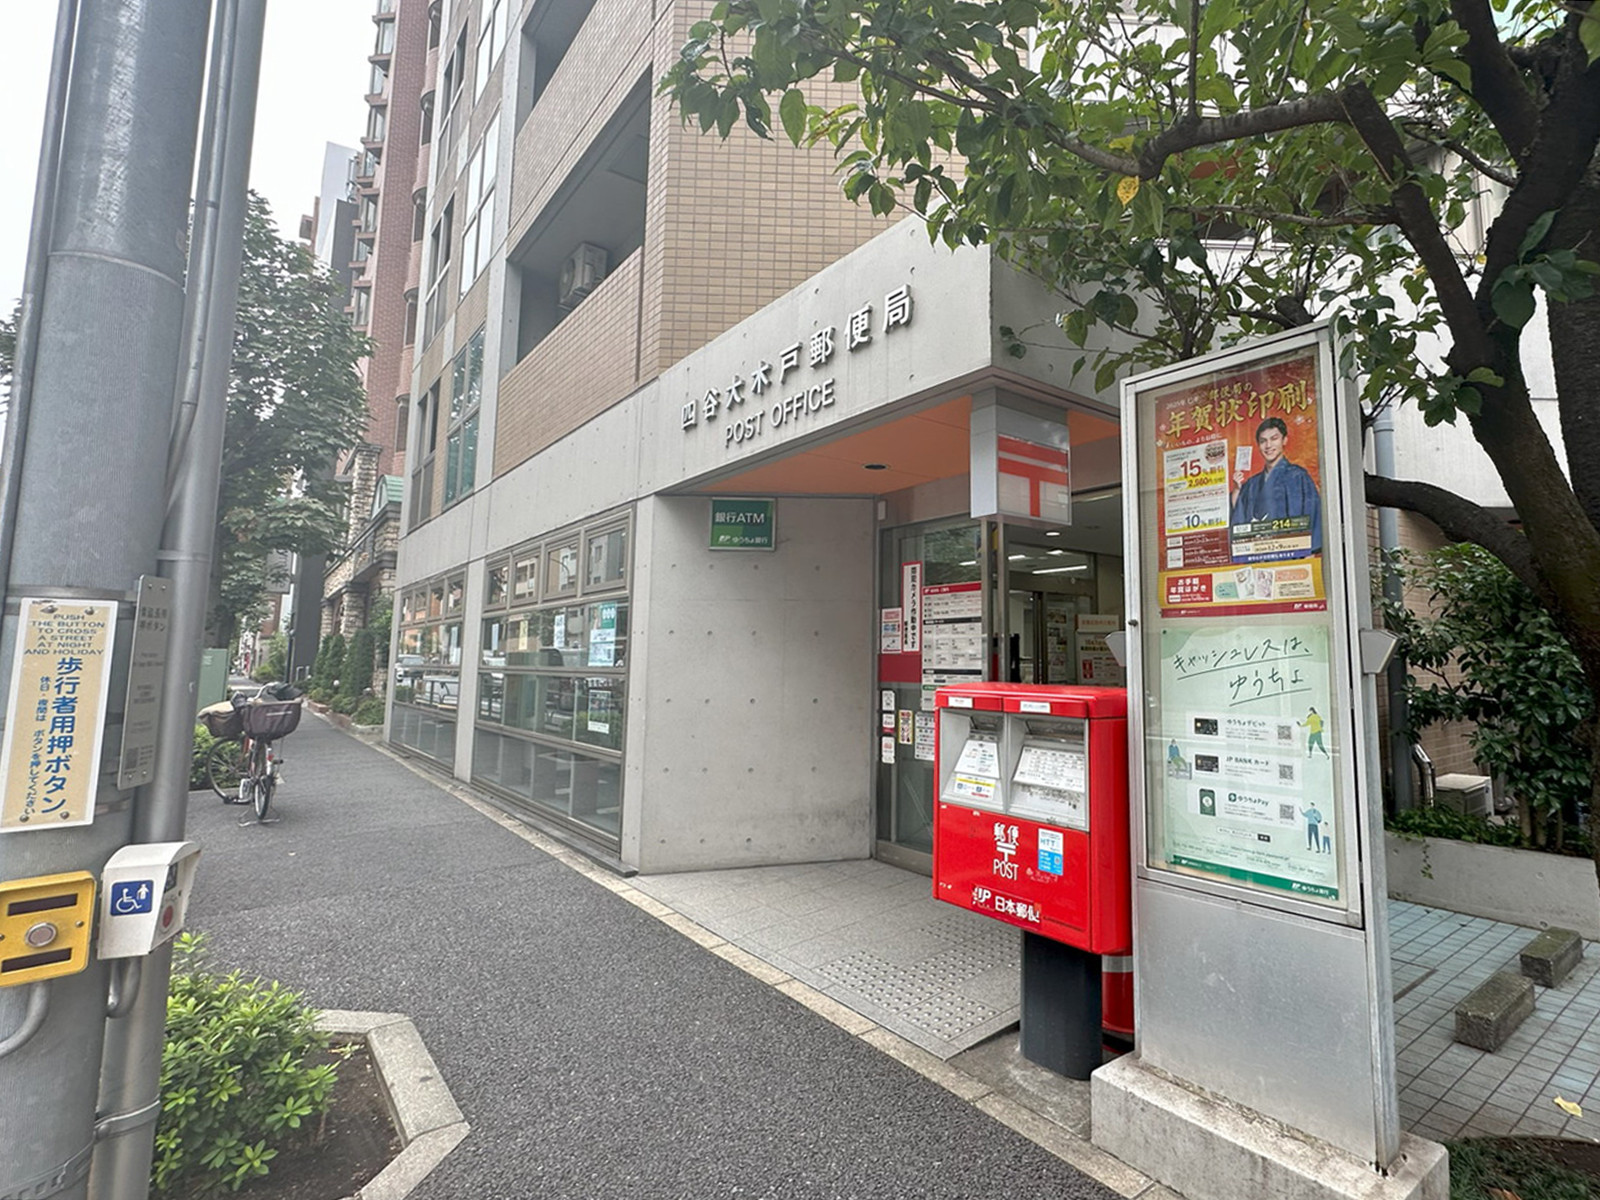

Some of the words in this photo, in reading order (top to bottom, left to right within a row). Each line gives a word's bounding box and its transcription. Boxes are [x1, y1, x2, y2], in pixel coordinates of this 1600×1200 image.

[679, 284, 912, 433] 四谷大木戸郵便局
[725, 411, 764, 447] POST
[771, 378, 835, 428] OFFICE
[1166, 380, 1307, 438] 年賀状印刷
[1174, 637, 1310, 673] キャッシュレスは、
[1229, 667, 1304, 700] ゆうちょ
[41, 656, 83, 813] 歩行者用押ボタン
[994, 822, 1019, 846] 郵便
[993, 859, 1019, 880] POST
